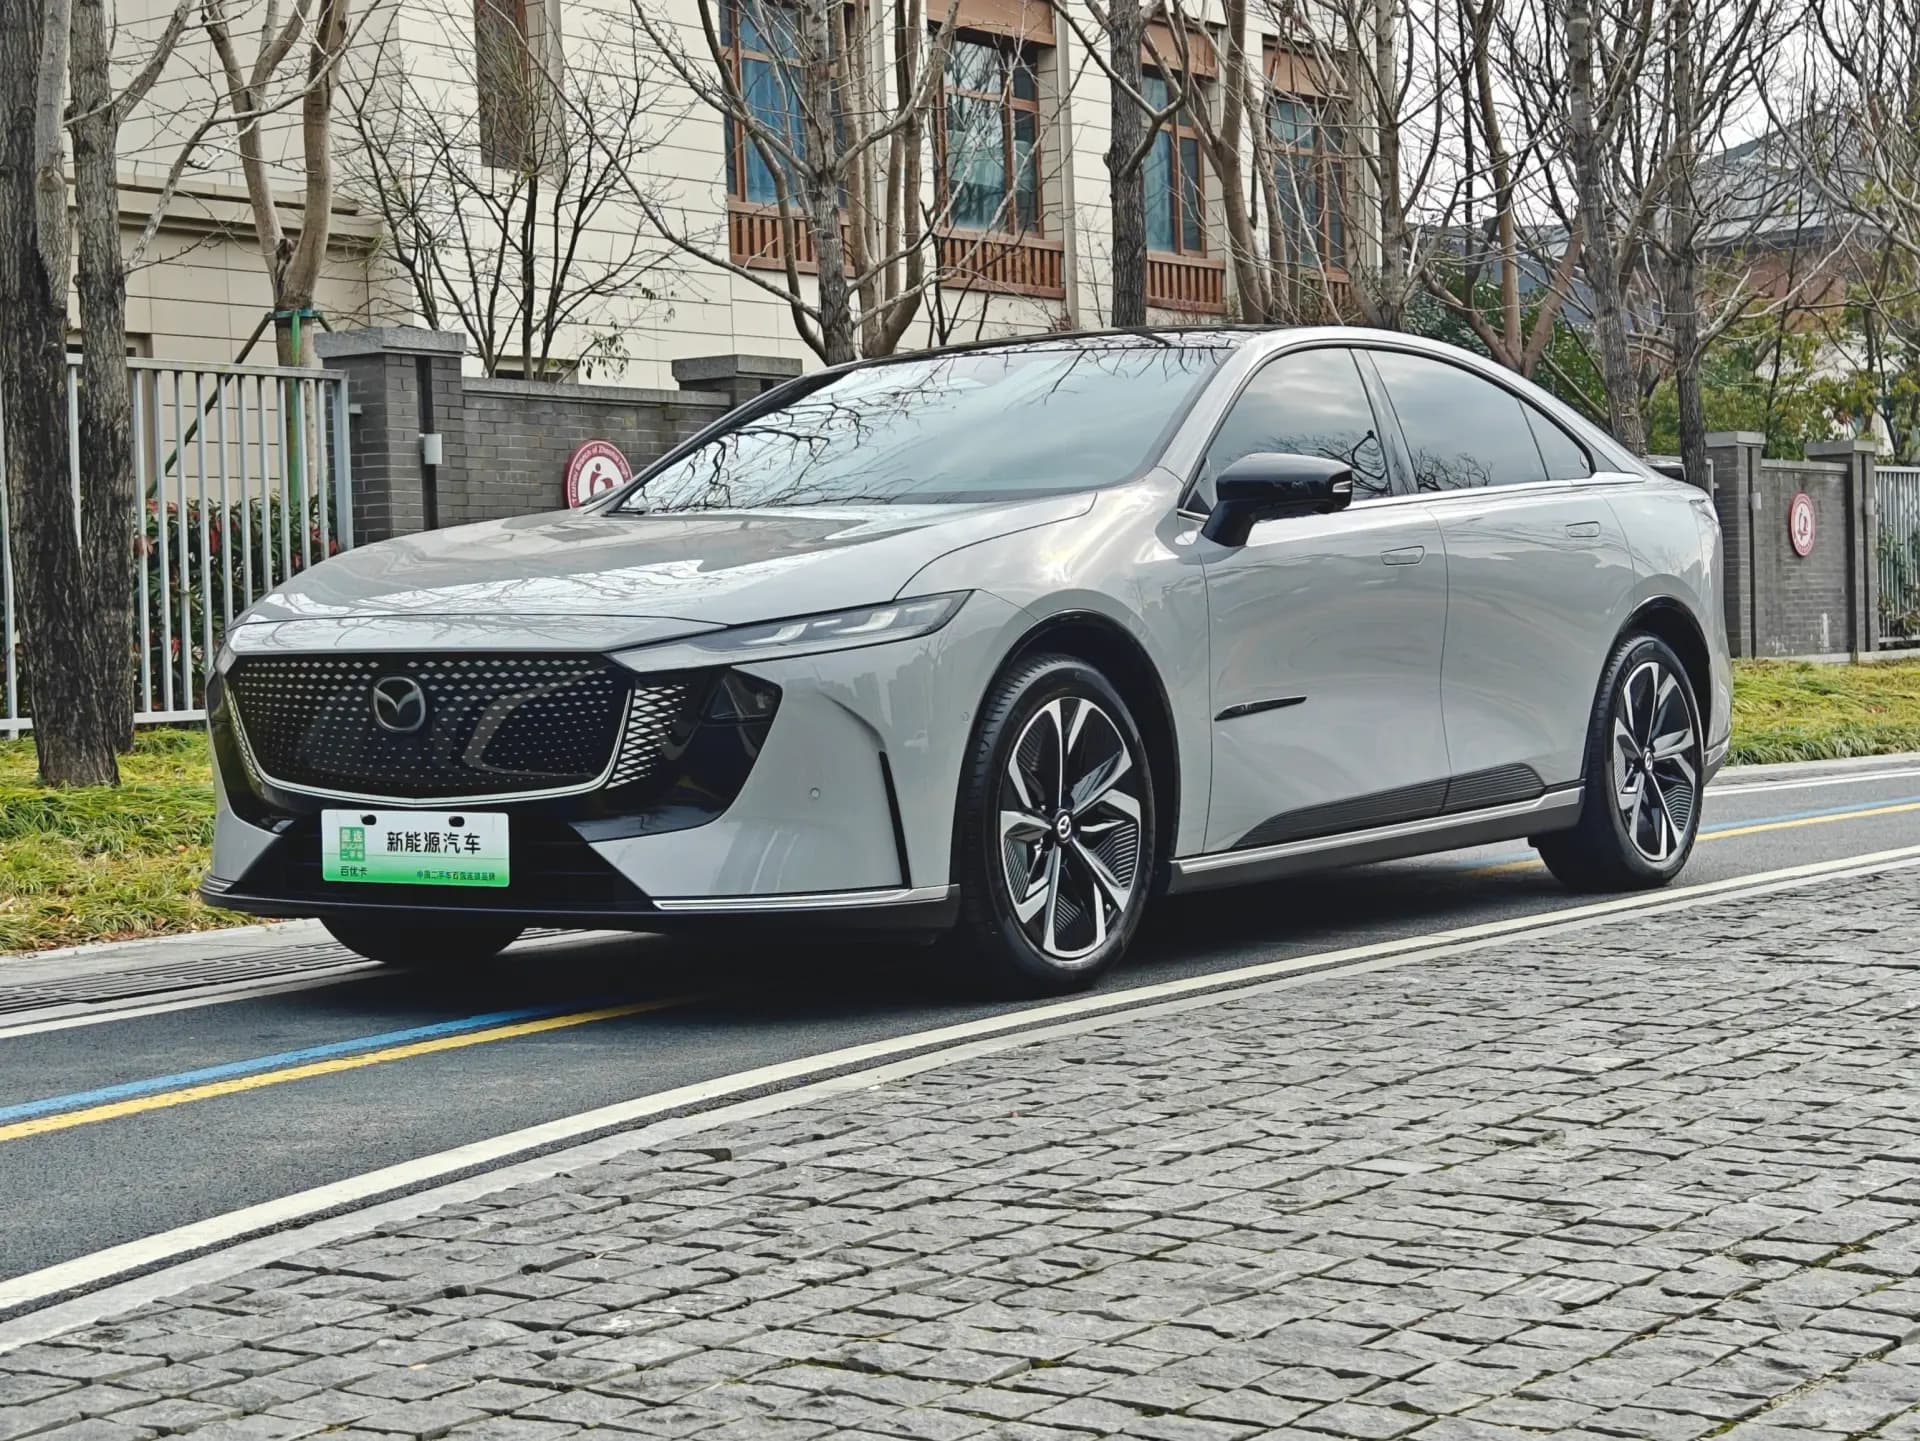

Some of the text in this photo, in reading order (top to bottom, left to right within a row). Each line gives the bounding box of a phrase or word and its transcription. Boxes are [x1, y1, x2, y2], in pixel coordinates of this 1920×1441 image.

[387, 831, 481, 854] 新能源汽车
[340, 866, 368, 877] 百优卡
